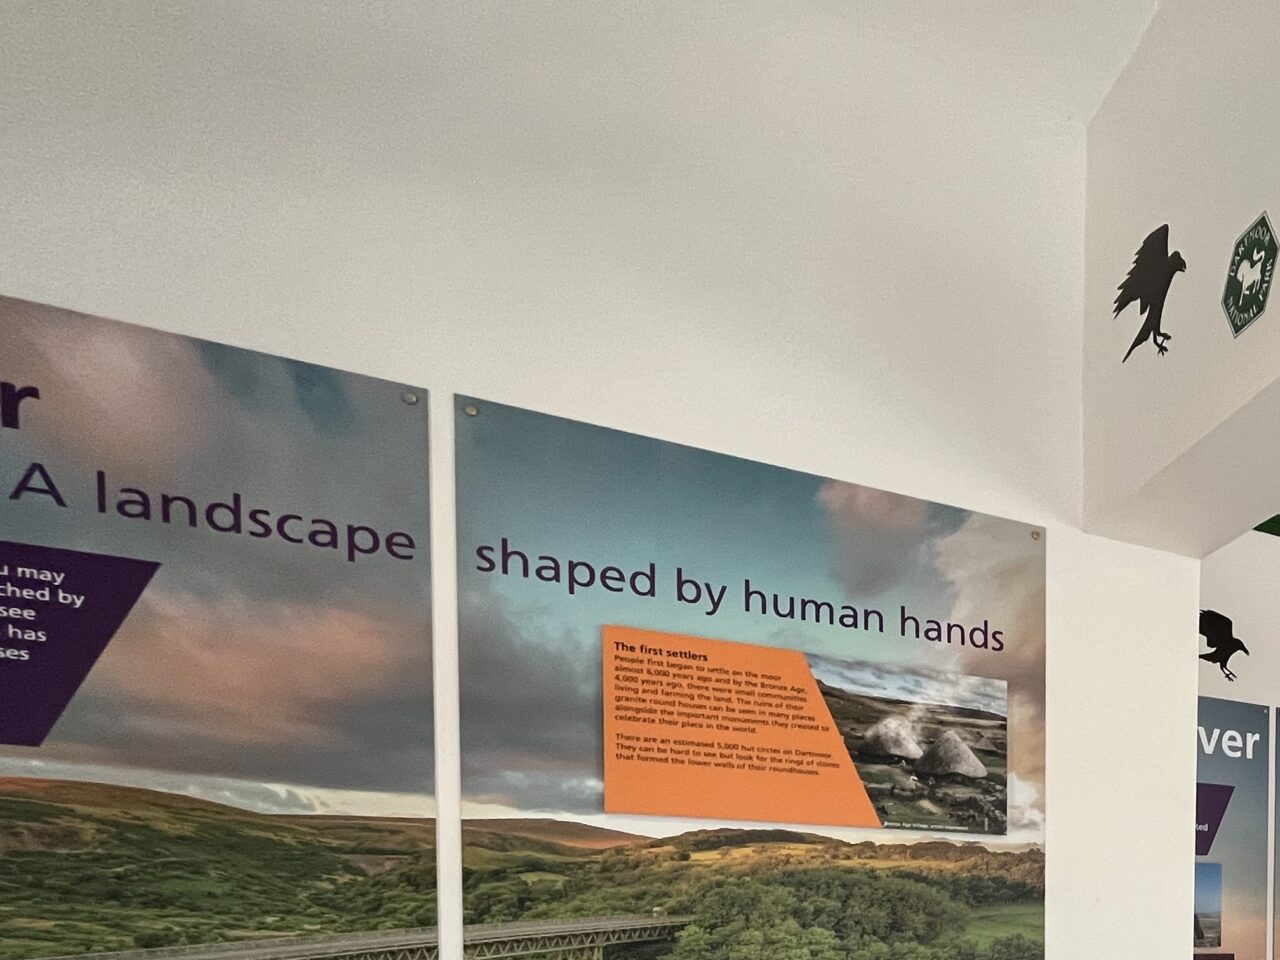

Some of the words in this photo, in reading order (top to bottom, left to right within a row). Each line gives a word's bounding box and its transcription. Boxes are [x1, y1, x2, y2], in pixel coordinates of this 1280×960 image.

[8, 462, 67, 507] A
[97, 470, 417, 562] landscape
[17, 566, 65, 586] may
[58, 588, 85, 609] by
[475, 537, 656, 597] shaped
[676, 567, 727, 616] by
[744, 579, 885, 633] human
[899, 605, 1005, 652] hands
[8, 623, 47, 642] has
[613, 641, 635, 652] The
[639, 645, 662, 655] first
[666, 648, 707, 661] settlers
